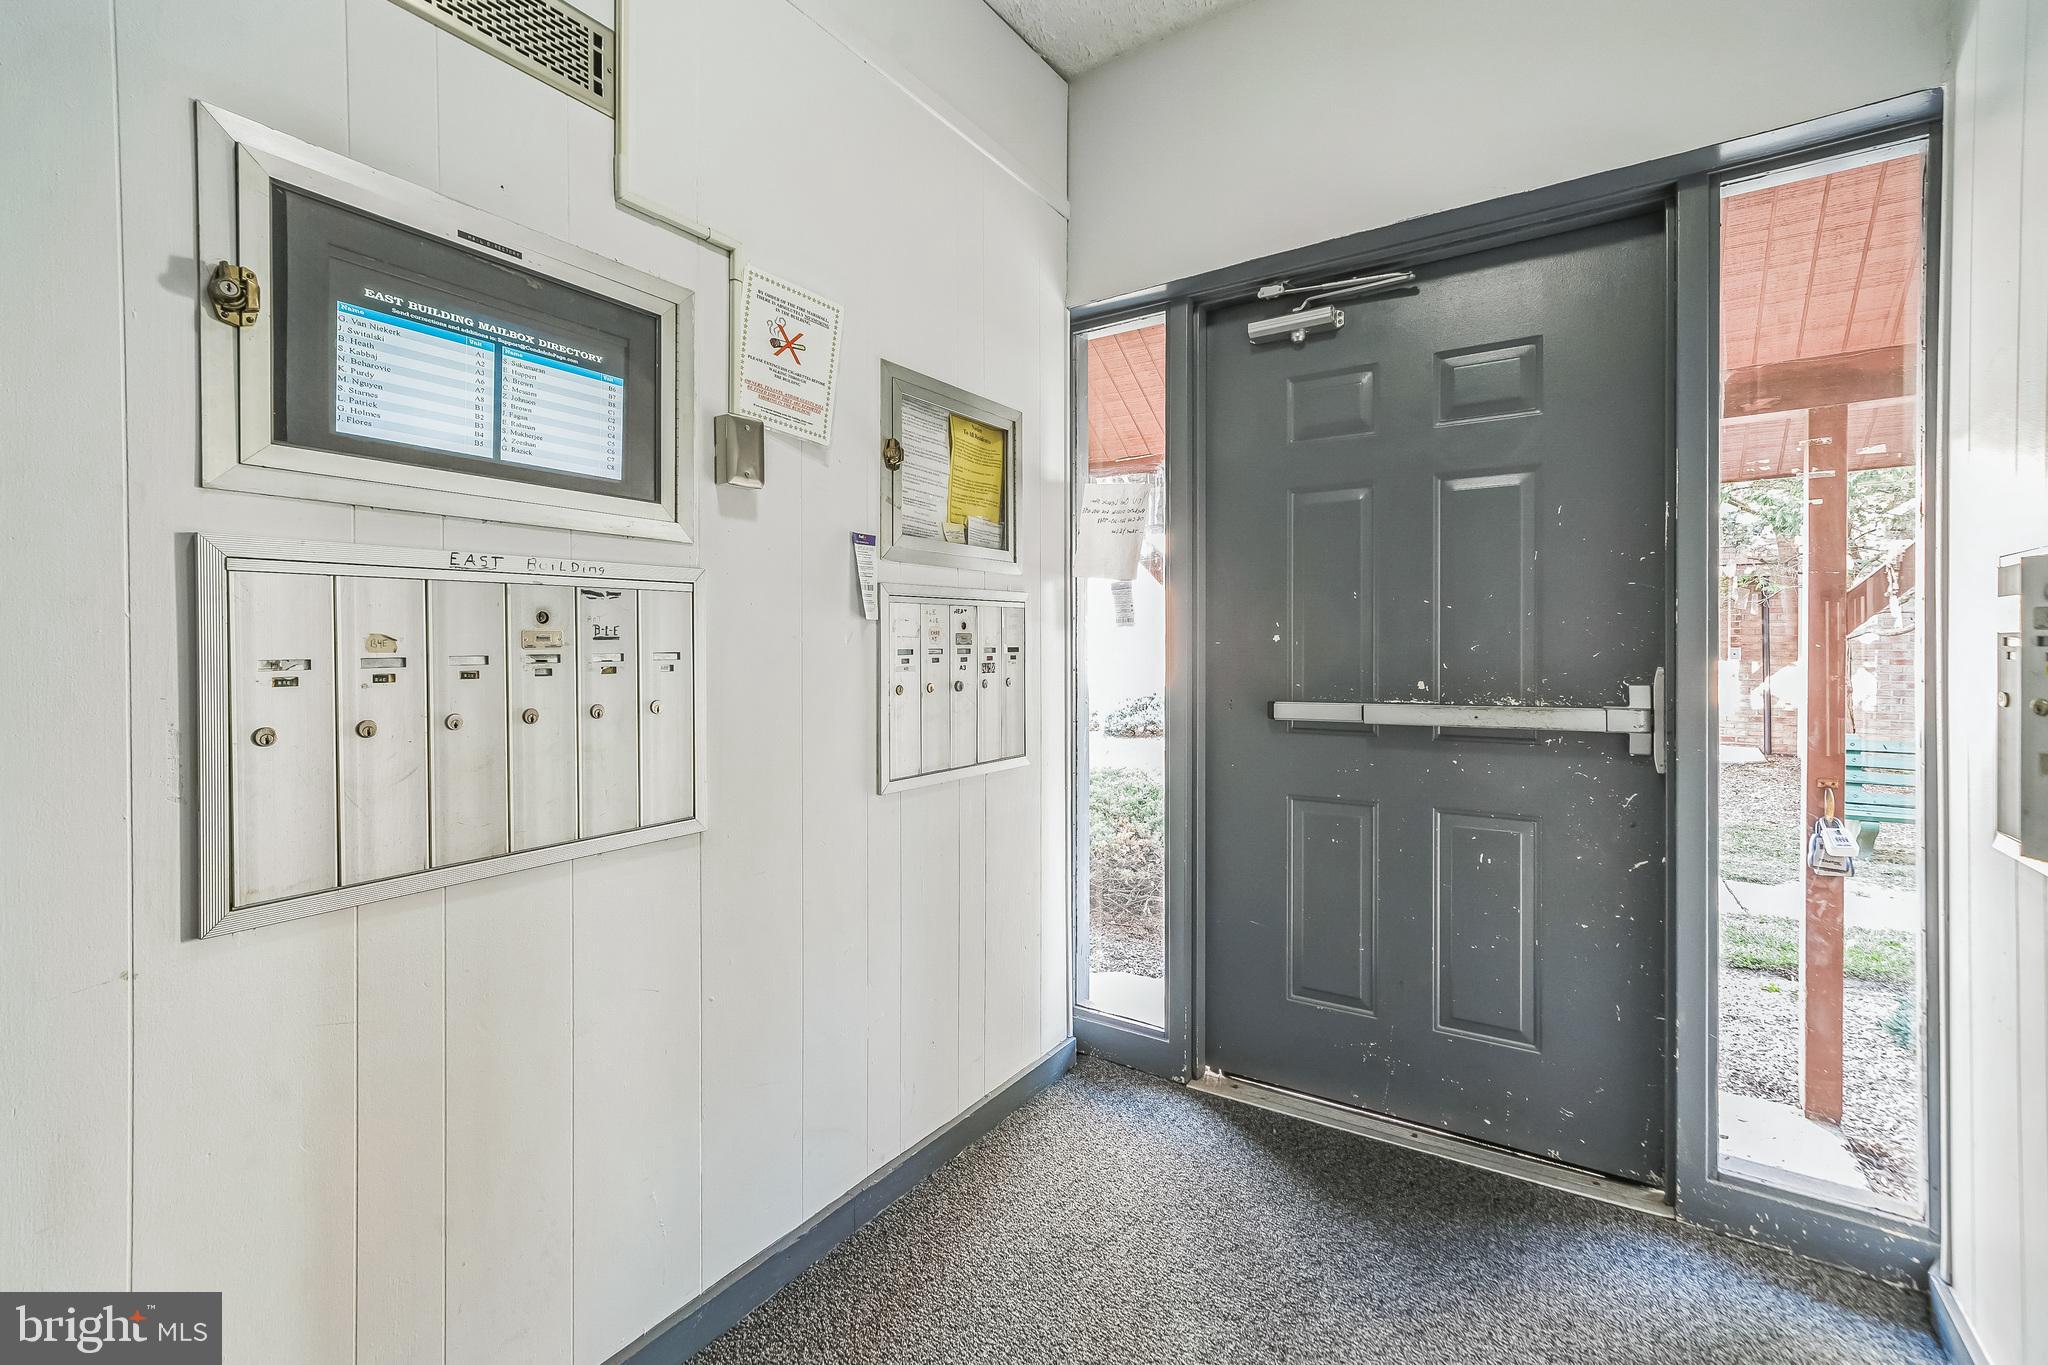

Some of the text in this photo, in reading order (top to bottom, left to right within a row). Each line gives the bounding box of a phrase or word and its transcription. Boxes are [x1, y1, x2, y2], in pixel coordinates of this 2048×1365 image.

[392, 308, 410, 317] Send
[410, 314, 447, 328] corrections
[338, 315, 348, 323] G.
[351, 318, 367, 328] Van
[369, 323, 401, 336] Niekerk
[341, 304, 483, 347] Name Unit
[364, 288, 604, 364] EAST BUILDING MAILBOX DIRECTORY
[348, 327, 385, 342] Switalski
[350, 338, 375, 350] Heath
[338, 355, 347, 363] N.
[349, 348, 378, 361] Kabbaj
[504, 349, 523, 358] Name
[338, 365, 347, 373] K.
[350, 368, 375, 380] Purdy
[338, 375, 349, 383] M.
[352, 378, 383, 390] Nguyen
[512, 378, 534, 388] Brown
[349, 387, 378, 399] Starnes
[349, 397, 378, 409] Patrick
[511, 395, 536, 406] Johnson
[350, 407, 381, 419] Holmes
[511, 404, 532, 413] Brown
[346, 417, 372, 427] Flores
[450, 552, 504, 568] EAST
